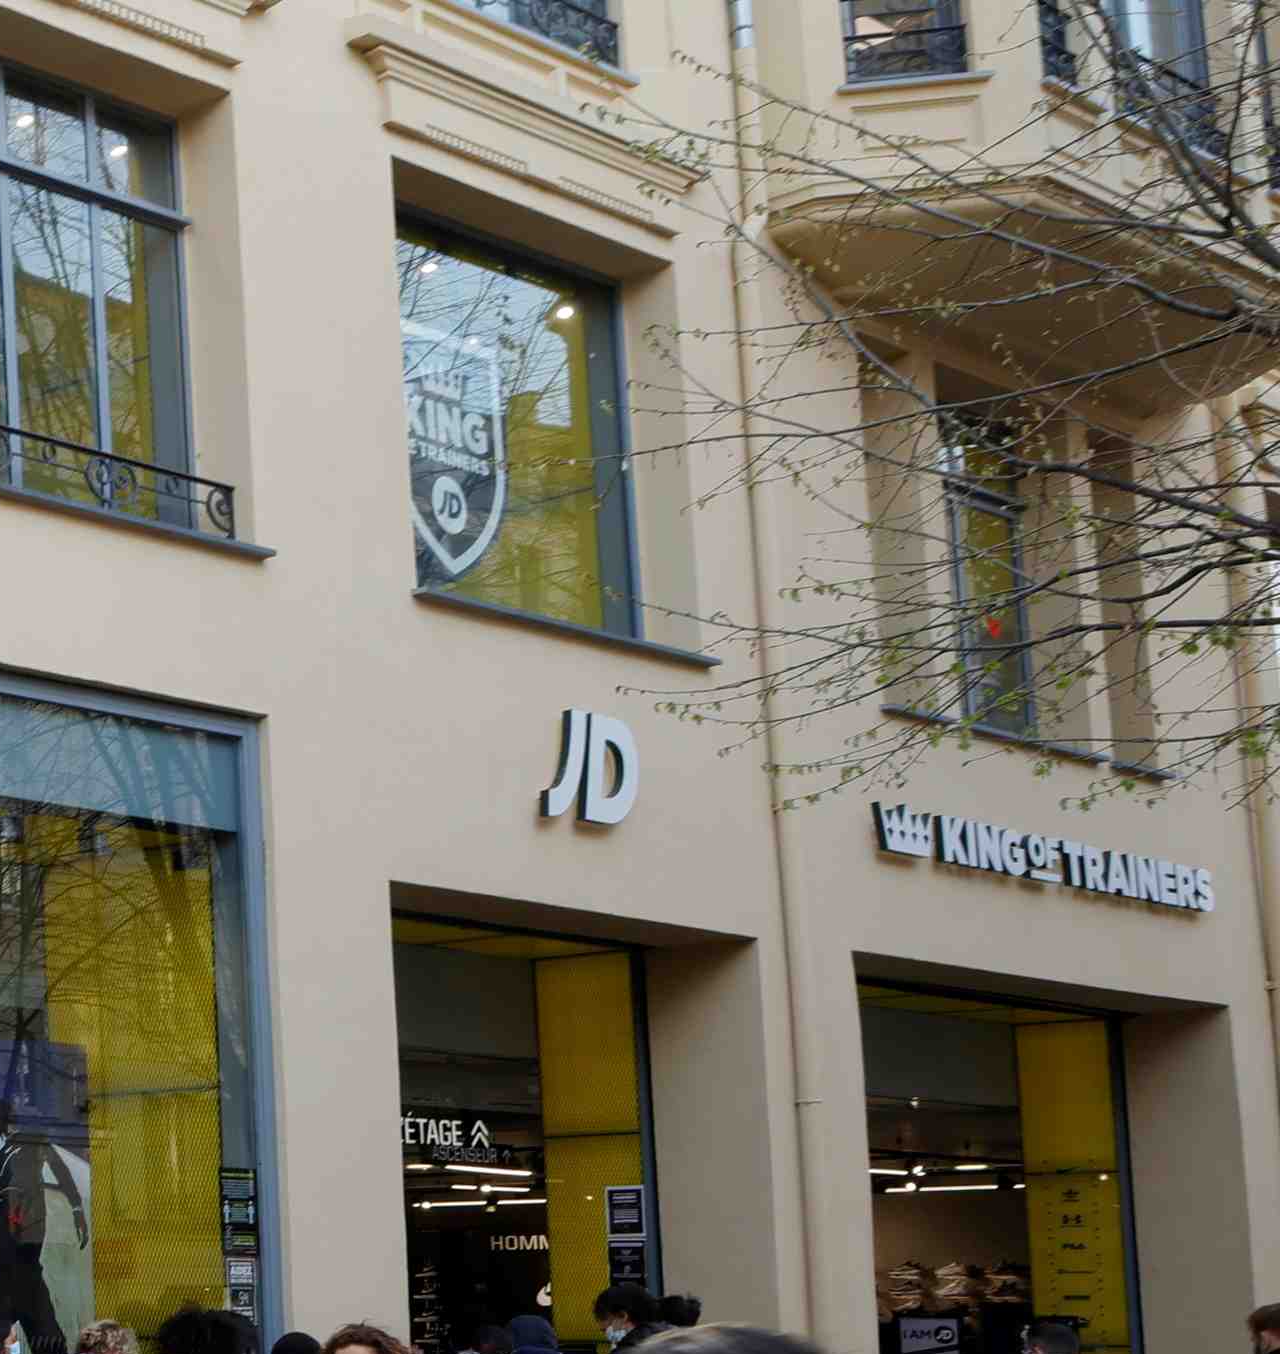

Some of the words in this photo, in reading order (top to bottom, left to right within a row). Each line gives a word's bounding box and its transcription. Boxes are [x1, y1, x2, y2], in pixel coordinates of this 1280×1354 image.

[418, 443, 490, 476] TRAINERS
[437, 489, 462, 520] JD
[539, 708, 641, 825] JD
[936, 814, 1028, 877] KING
[1027, 832, 1062, 870] OF
[1061, 840, 1216, 912] TRAINERS
